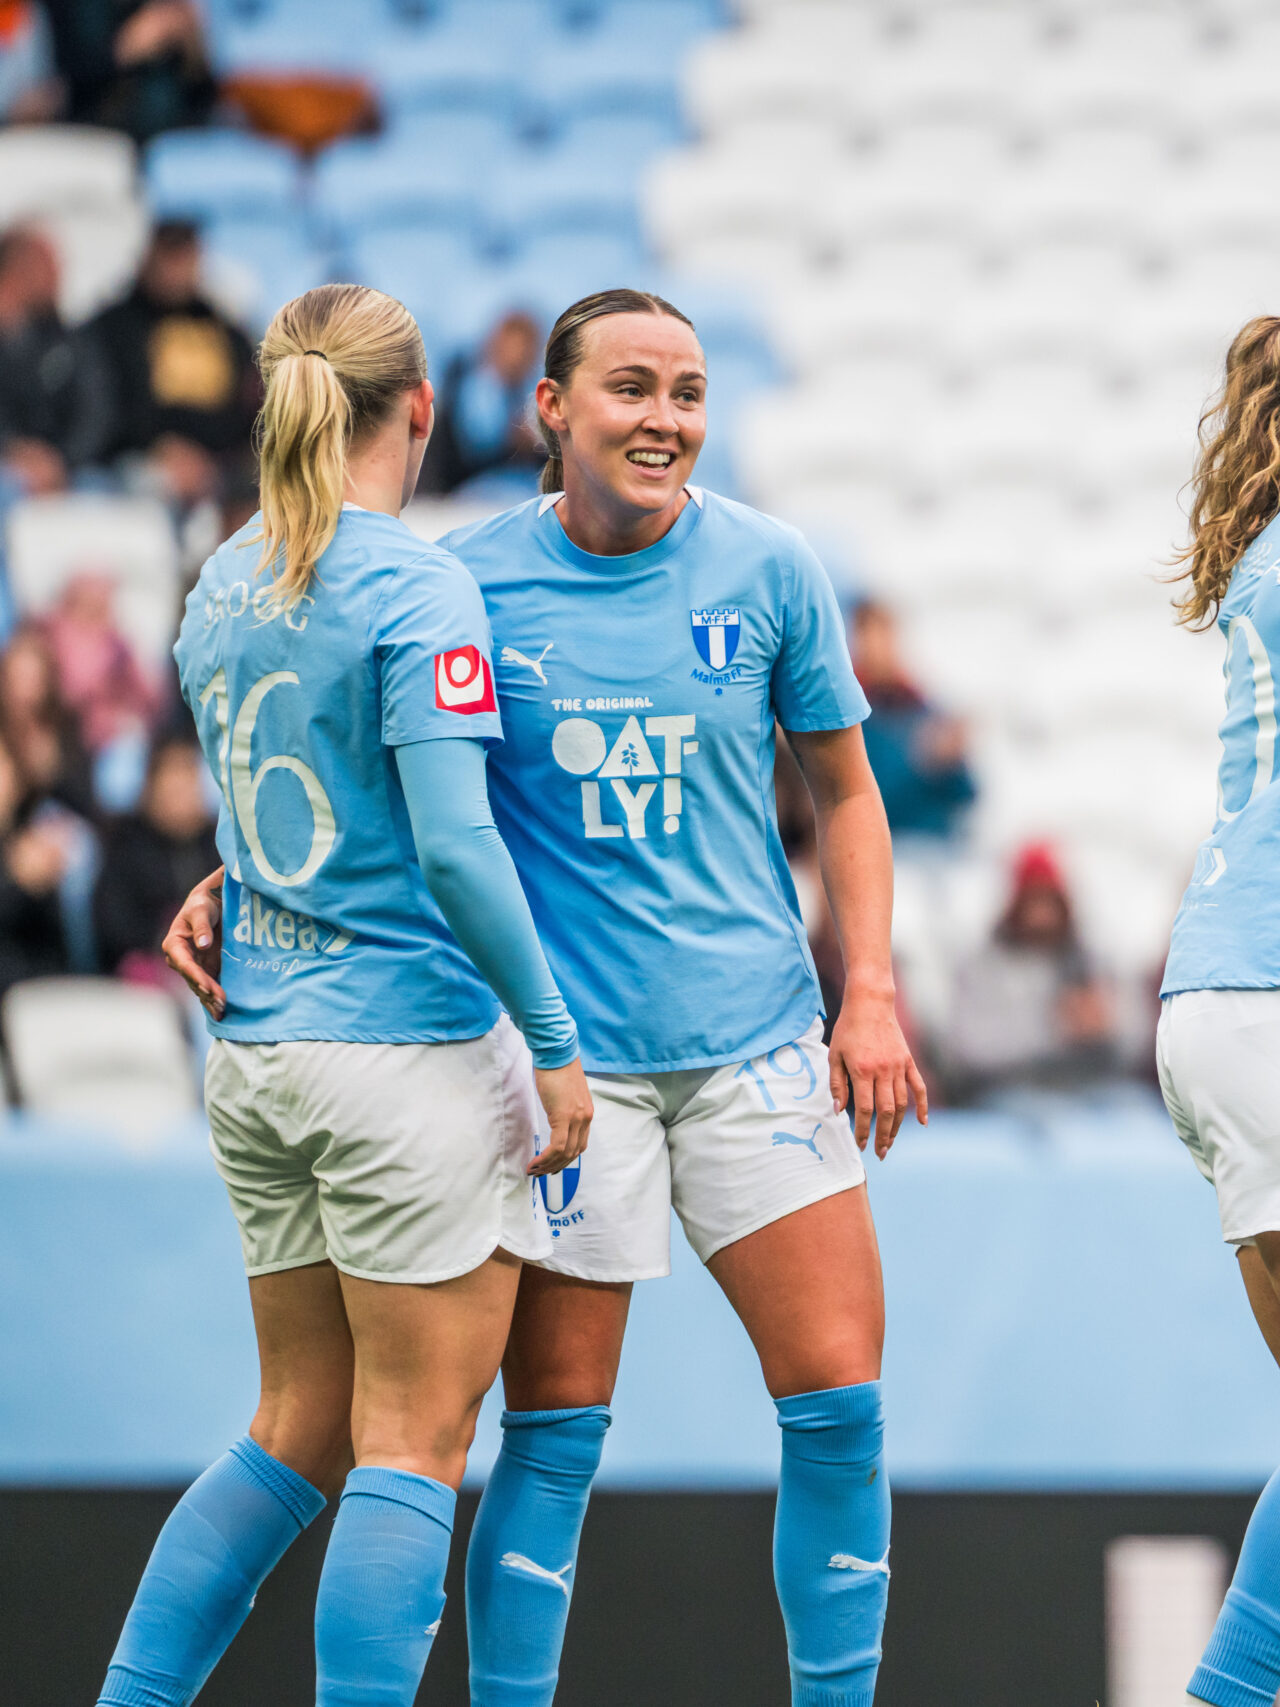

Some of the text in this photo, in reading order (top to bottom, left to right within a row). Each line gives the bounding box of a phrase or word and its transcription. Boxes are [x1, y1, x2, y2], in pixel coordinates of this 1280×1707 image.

[551, 696, 654, 712] THE ORIGINAL
[690, 665, 742, 685] Malmö FF
[198, 666, 336, 887] 16
[580, 777, 682, 839] LY!
[233, 893, 319, 953] akea
[734, 1041, 817, 1111] 19
[570, 1208, 585, 1224] FF
